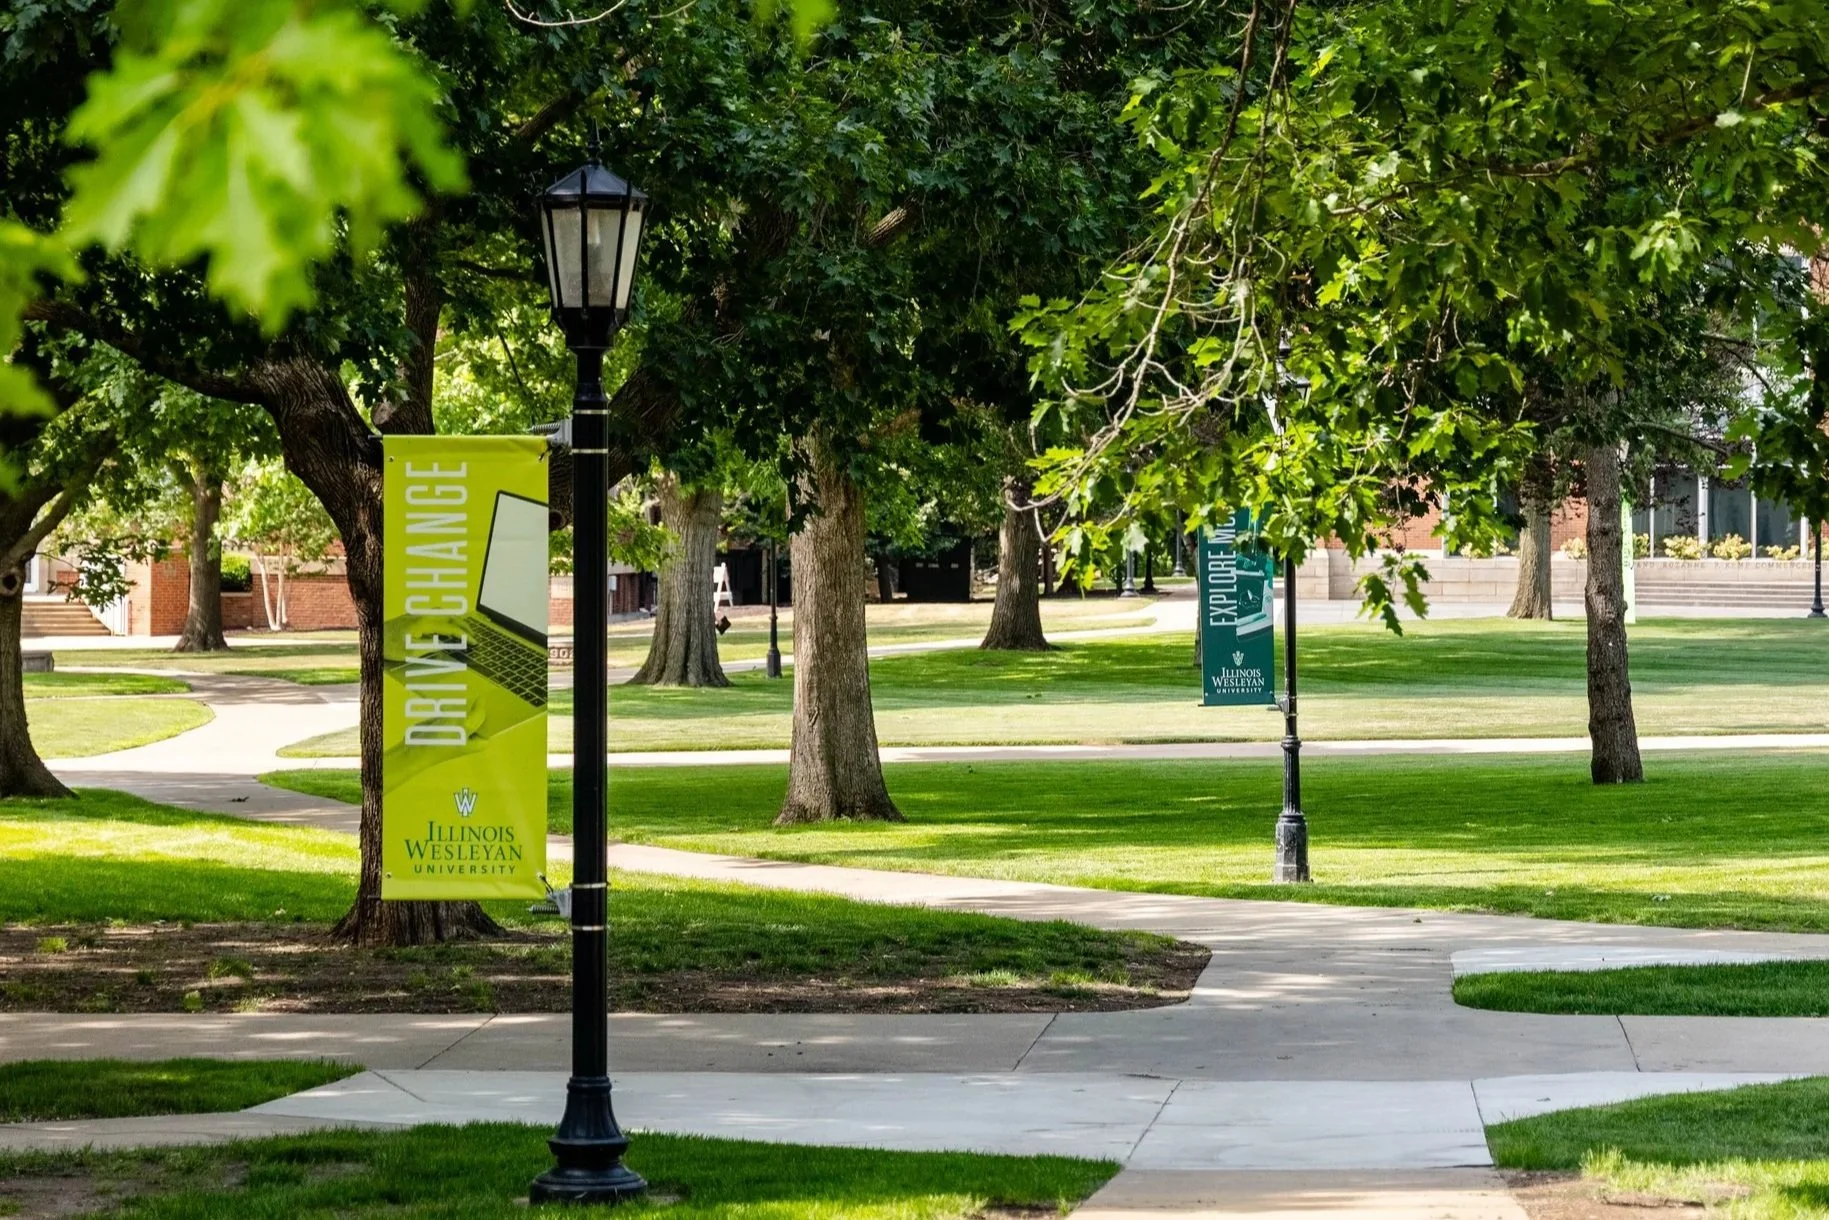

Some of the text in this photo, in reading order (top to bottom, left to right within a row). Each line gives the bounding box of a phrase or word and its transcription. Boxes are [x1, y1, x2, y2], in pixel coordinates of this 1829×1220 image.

[1208, 550, 1238, 626] EXPLORE
[405, 461, 468, 746] DRIVE CHANGE
[1211, 675, 1265, 687] WESLEYAN
[1221, 667, 1261, 678] ILLINOIS
[428, 820, 515, 842] ILLINOIS
[404, 838, 523, 861] WESLEYAN
[414, 864, 517, 874] UNIVERSITY
